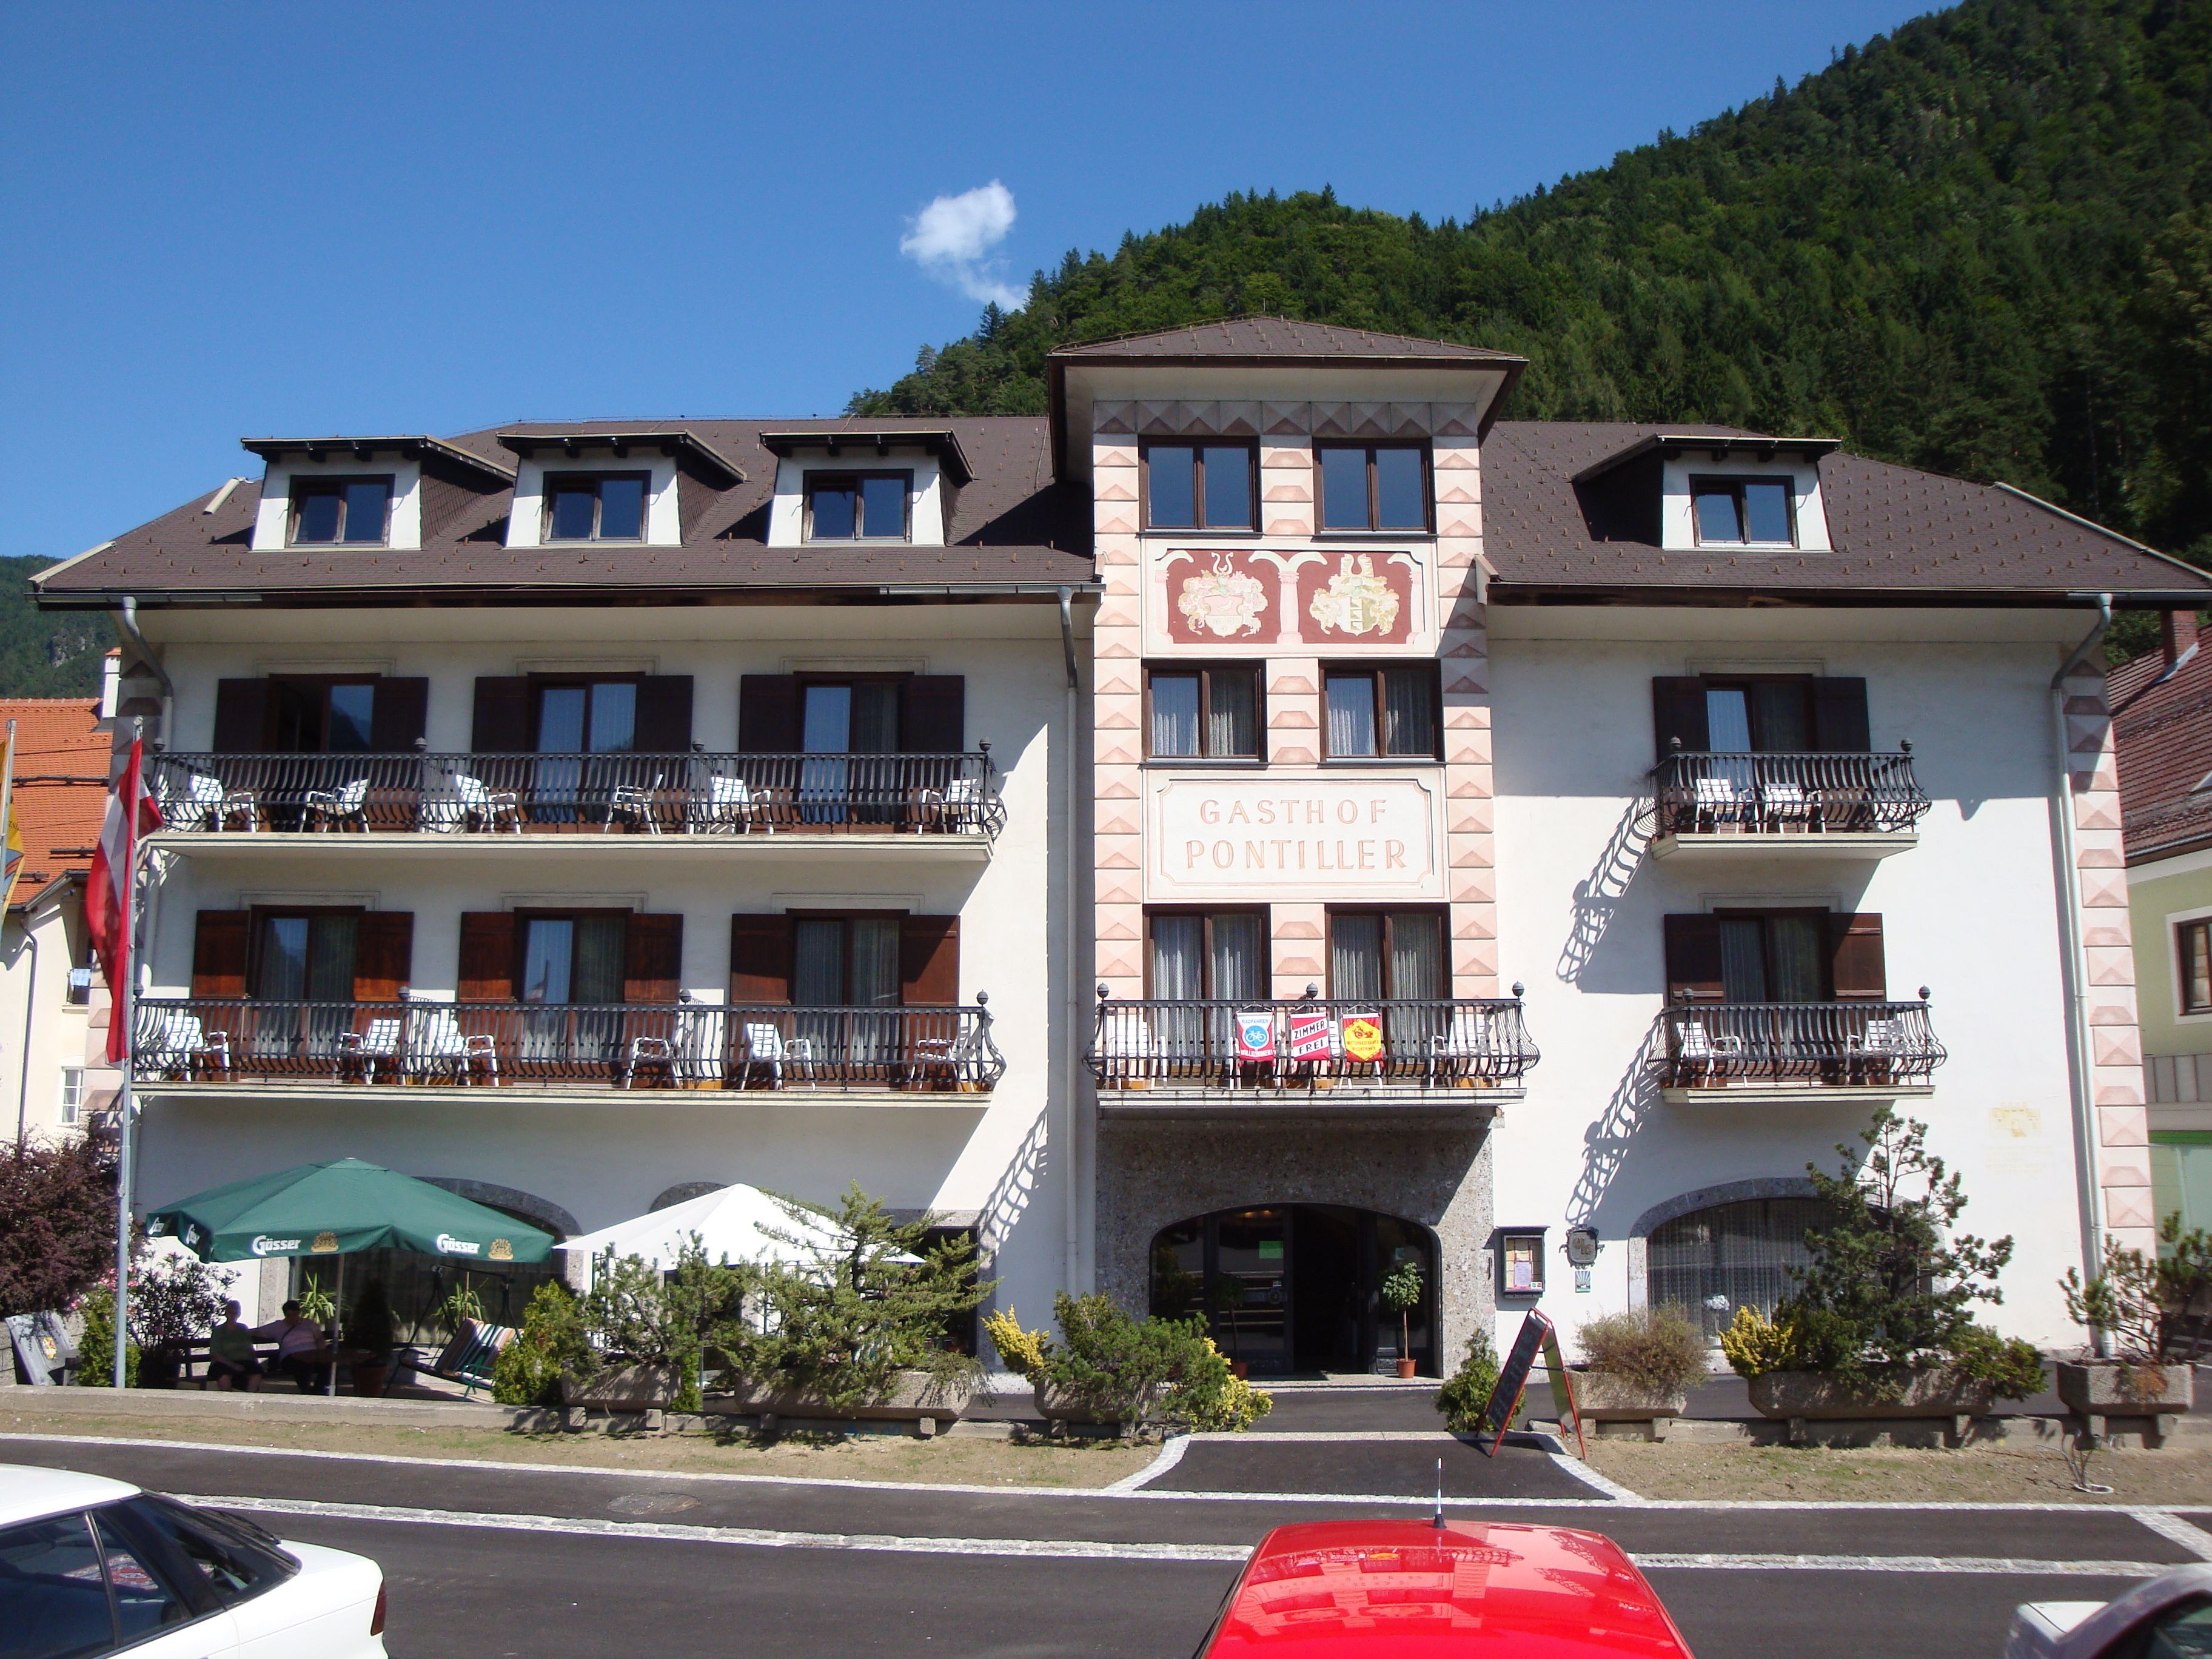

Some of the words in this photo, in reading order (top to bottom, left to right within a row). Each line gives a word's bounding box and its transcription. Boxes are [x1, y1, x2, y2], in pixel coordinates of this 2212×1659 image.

[1200, 799, 1387, 825] GASTHOF
[1186, 839, 1407, 870] PONTILLER
[1294, 1021, 1325, 1039] ZIMMER
[1299, 1039, 1323, 1054] FREI
[252, 1235, 301, 1255] Gösser
[437, 1233, 480, 1255] Gösser
